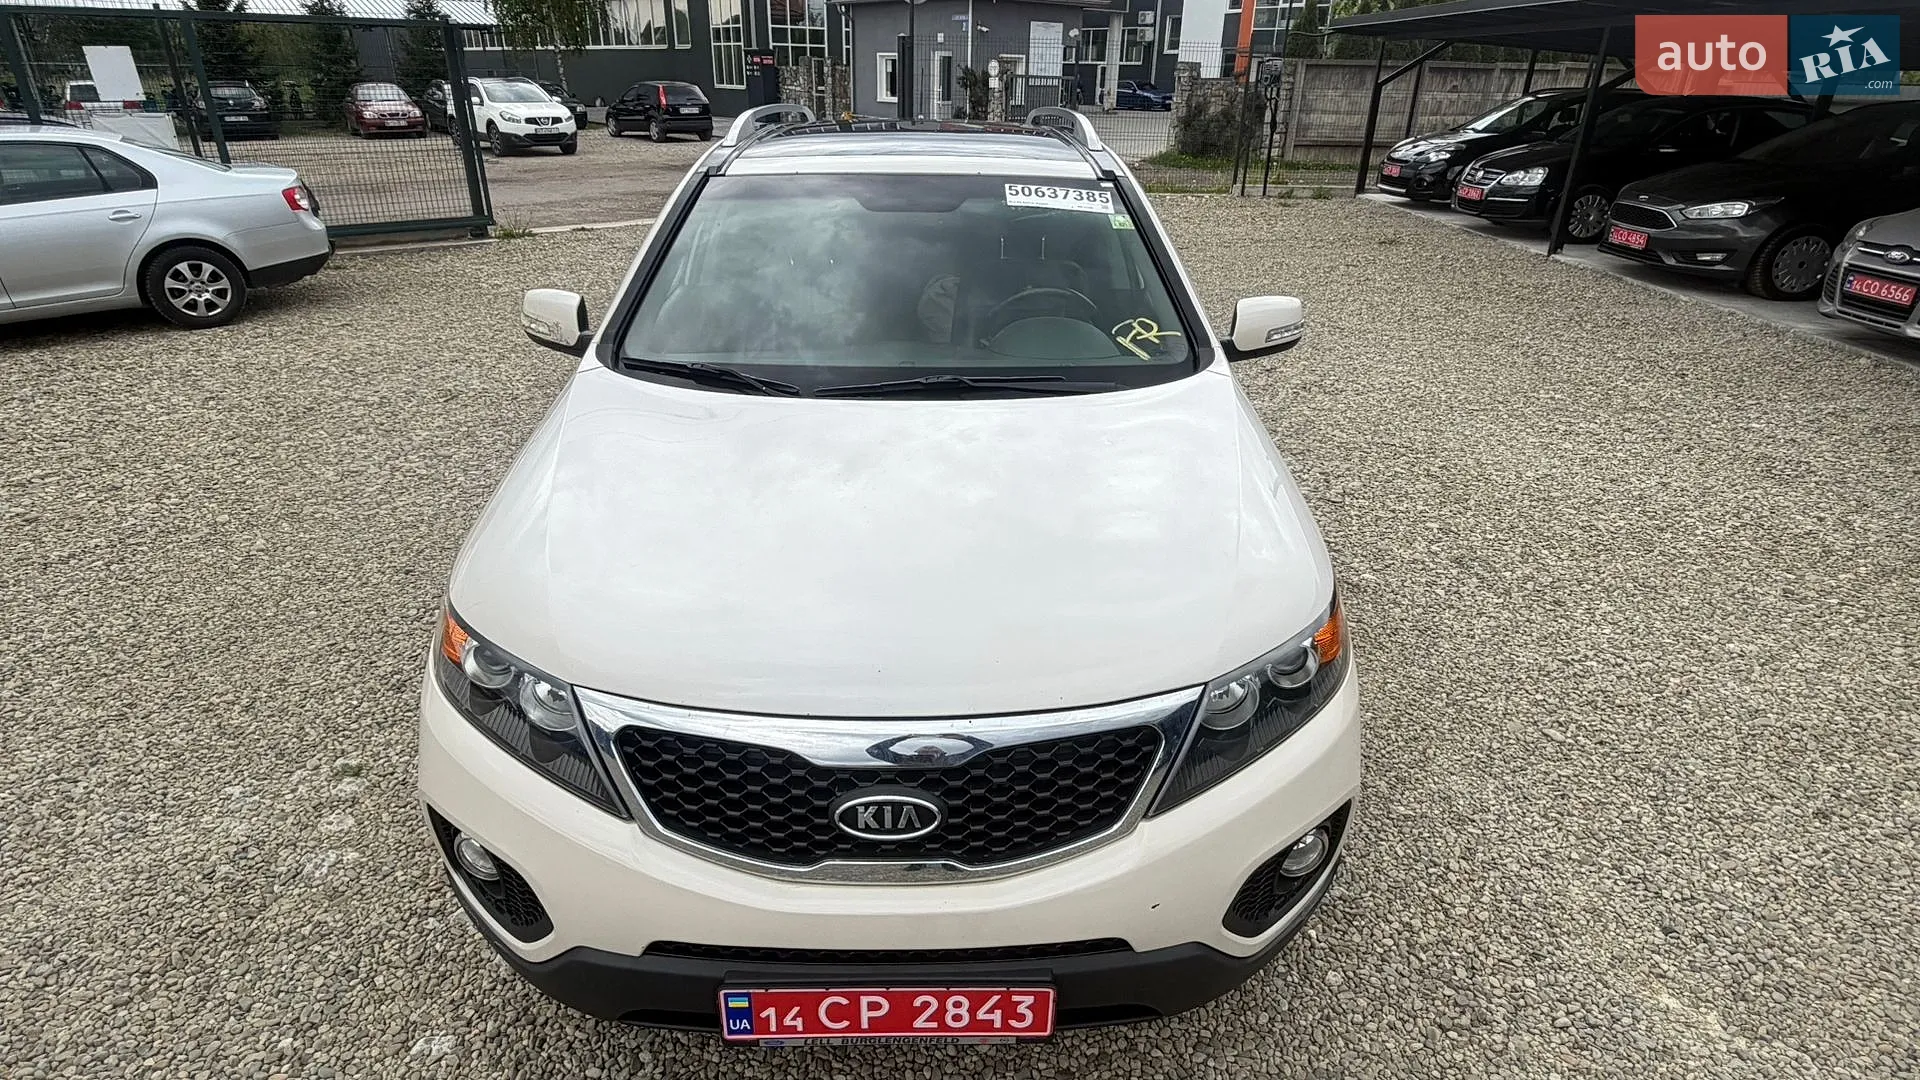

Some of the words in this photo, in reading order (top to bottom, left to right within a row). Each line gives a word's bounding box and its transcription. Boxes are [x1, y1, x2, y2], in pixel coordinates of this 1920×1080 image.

[1008, 185, 1110, 204] 50637385
[1881, 284, 1911, 302] 6566
[855, 805, 921, 829] KIA
[759, 1006, 803, 1032] 14
[818, 995, 890, 1029] CP
[912, 994, 1035, 1029] 2843
[729, 1018, 751, 1030] UA
